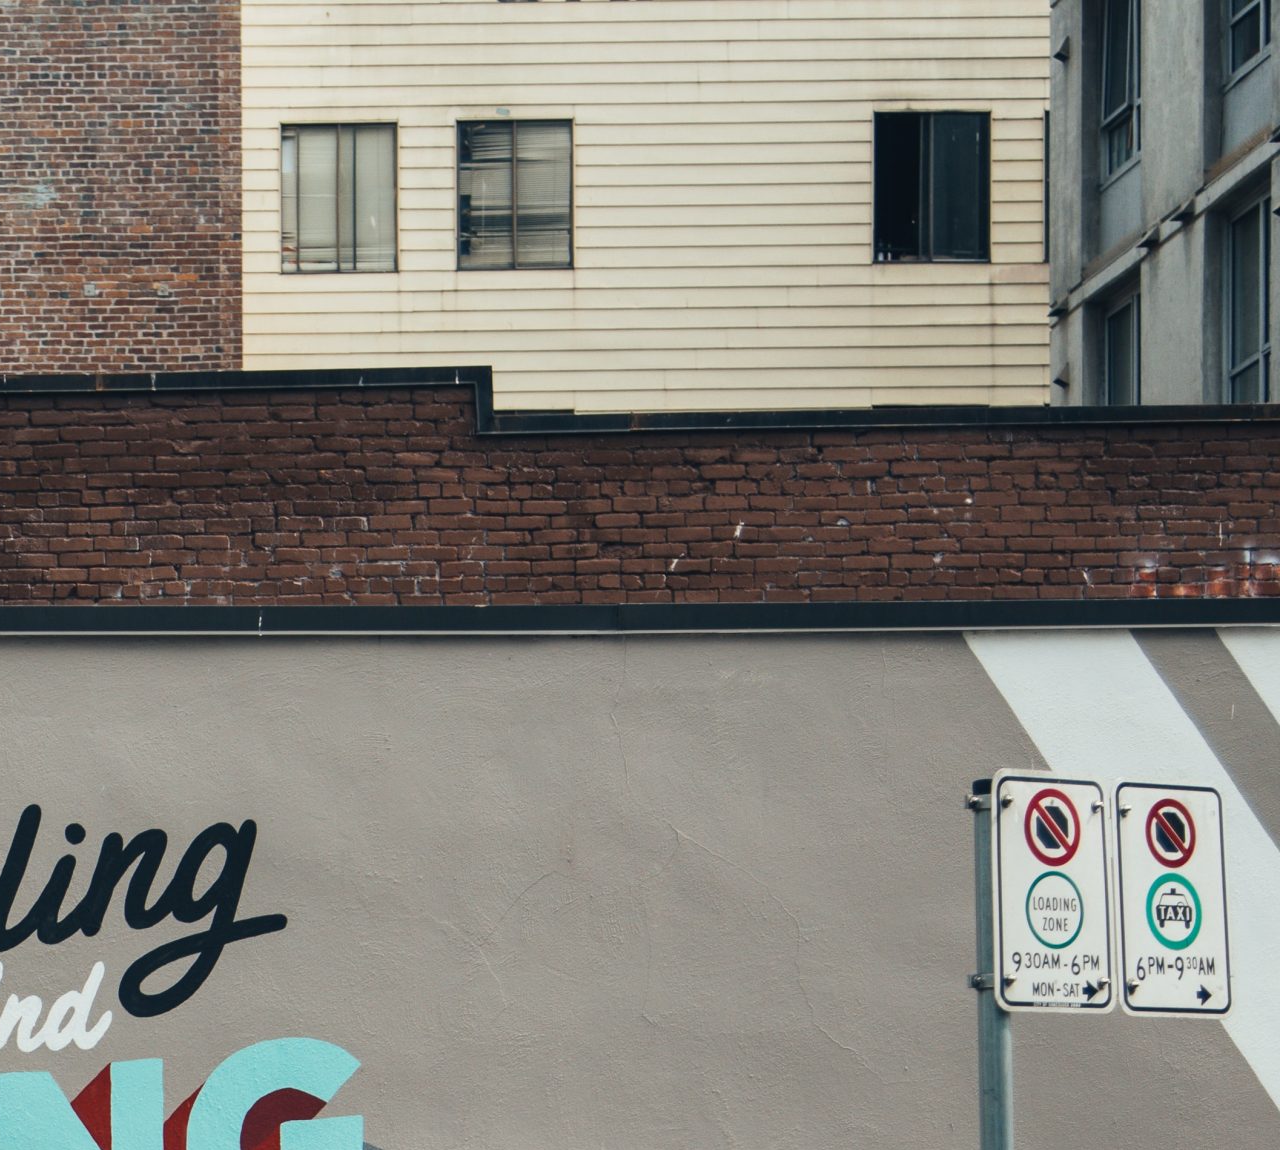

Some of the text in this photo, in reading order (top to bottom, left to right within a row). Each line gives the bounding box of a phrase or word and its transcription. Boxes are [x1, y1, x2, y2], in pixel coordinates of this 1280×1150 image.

[1032, 896, 1078, 913] LOADING
[1158, 906, 1191, 921] TAXI
[1042, 917, 1069, 932] ZONE
